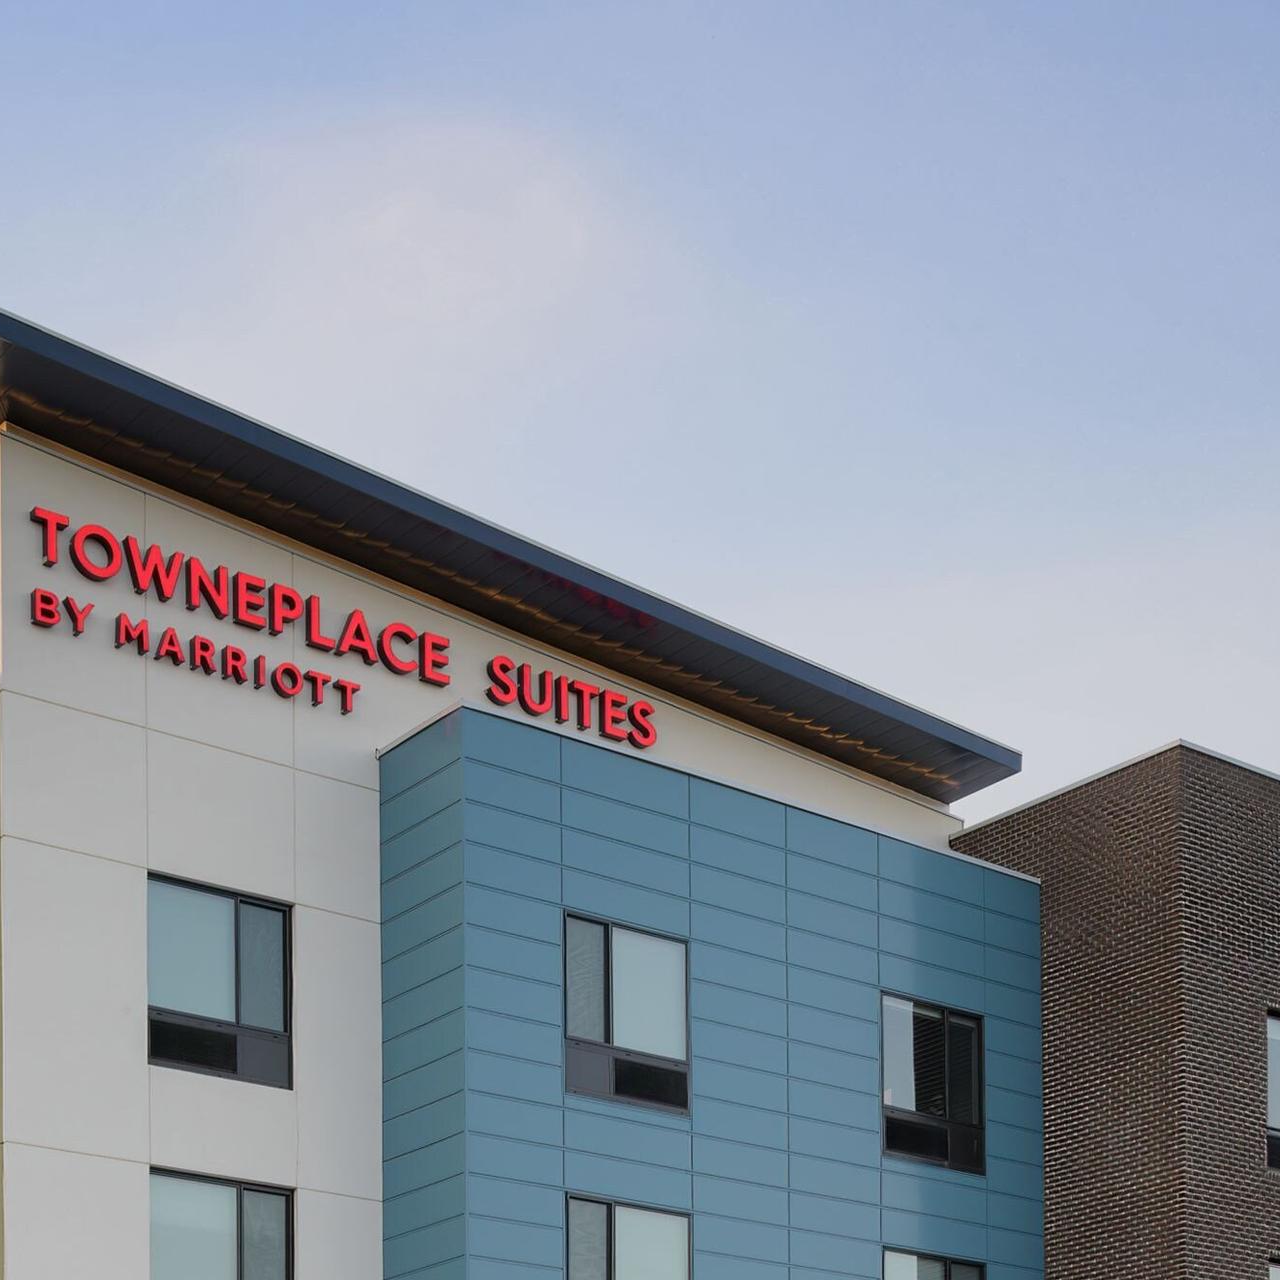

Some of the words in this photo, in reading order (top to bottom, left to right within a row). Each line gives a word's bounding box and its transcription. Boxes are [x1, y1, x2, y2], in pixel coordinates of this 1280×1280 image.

[30, 506, 451, 686] TOWNEPLACE
[486, 655, 657, 748] SUITES
[31, 588, 94, 635] BY
[115, 613, 361, 714] MARRIOTT
